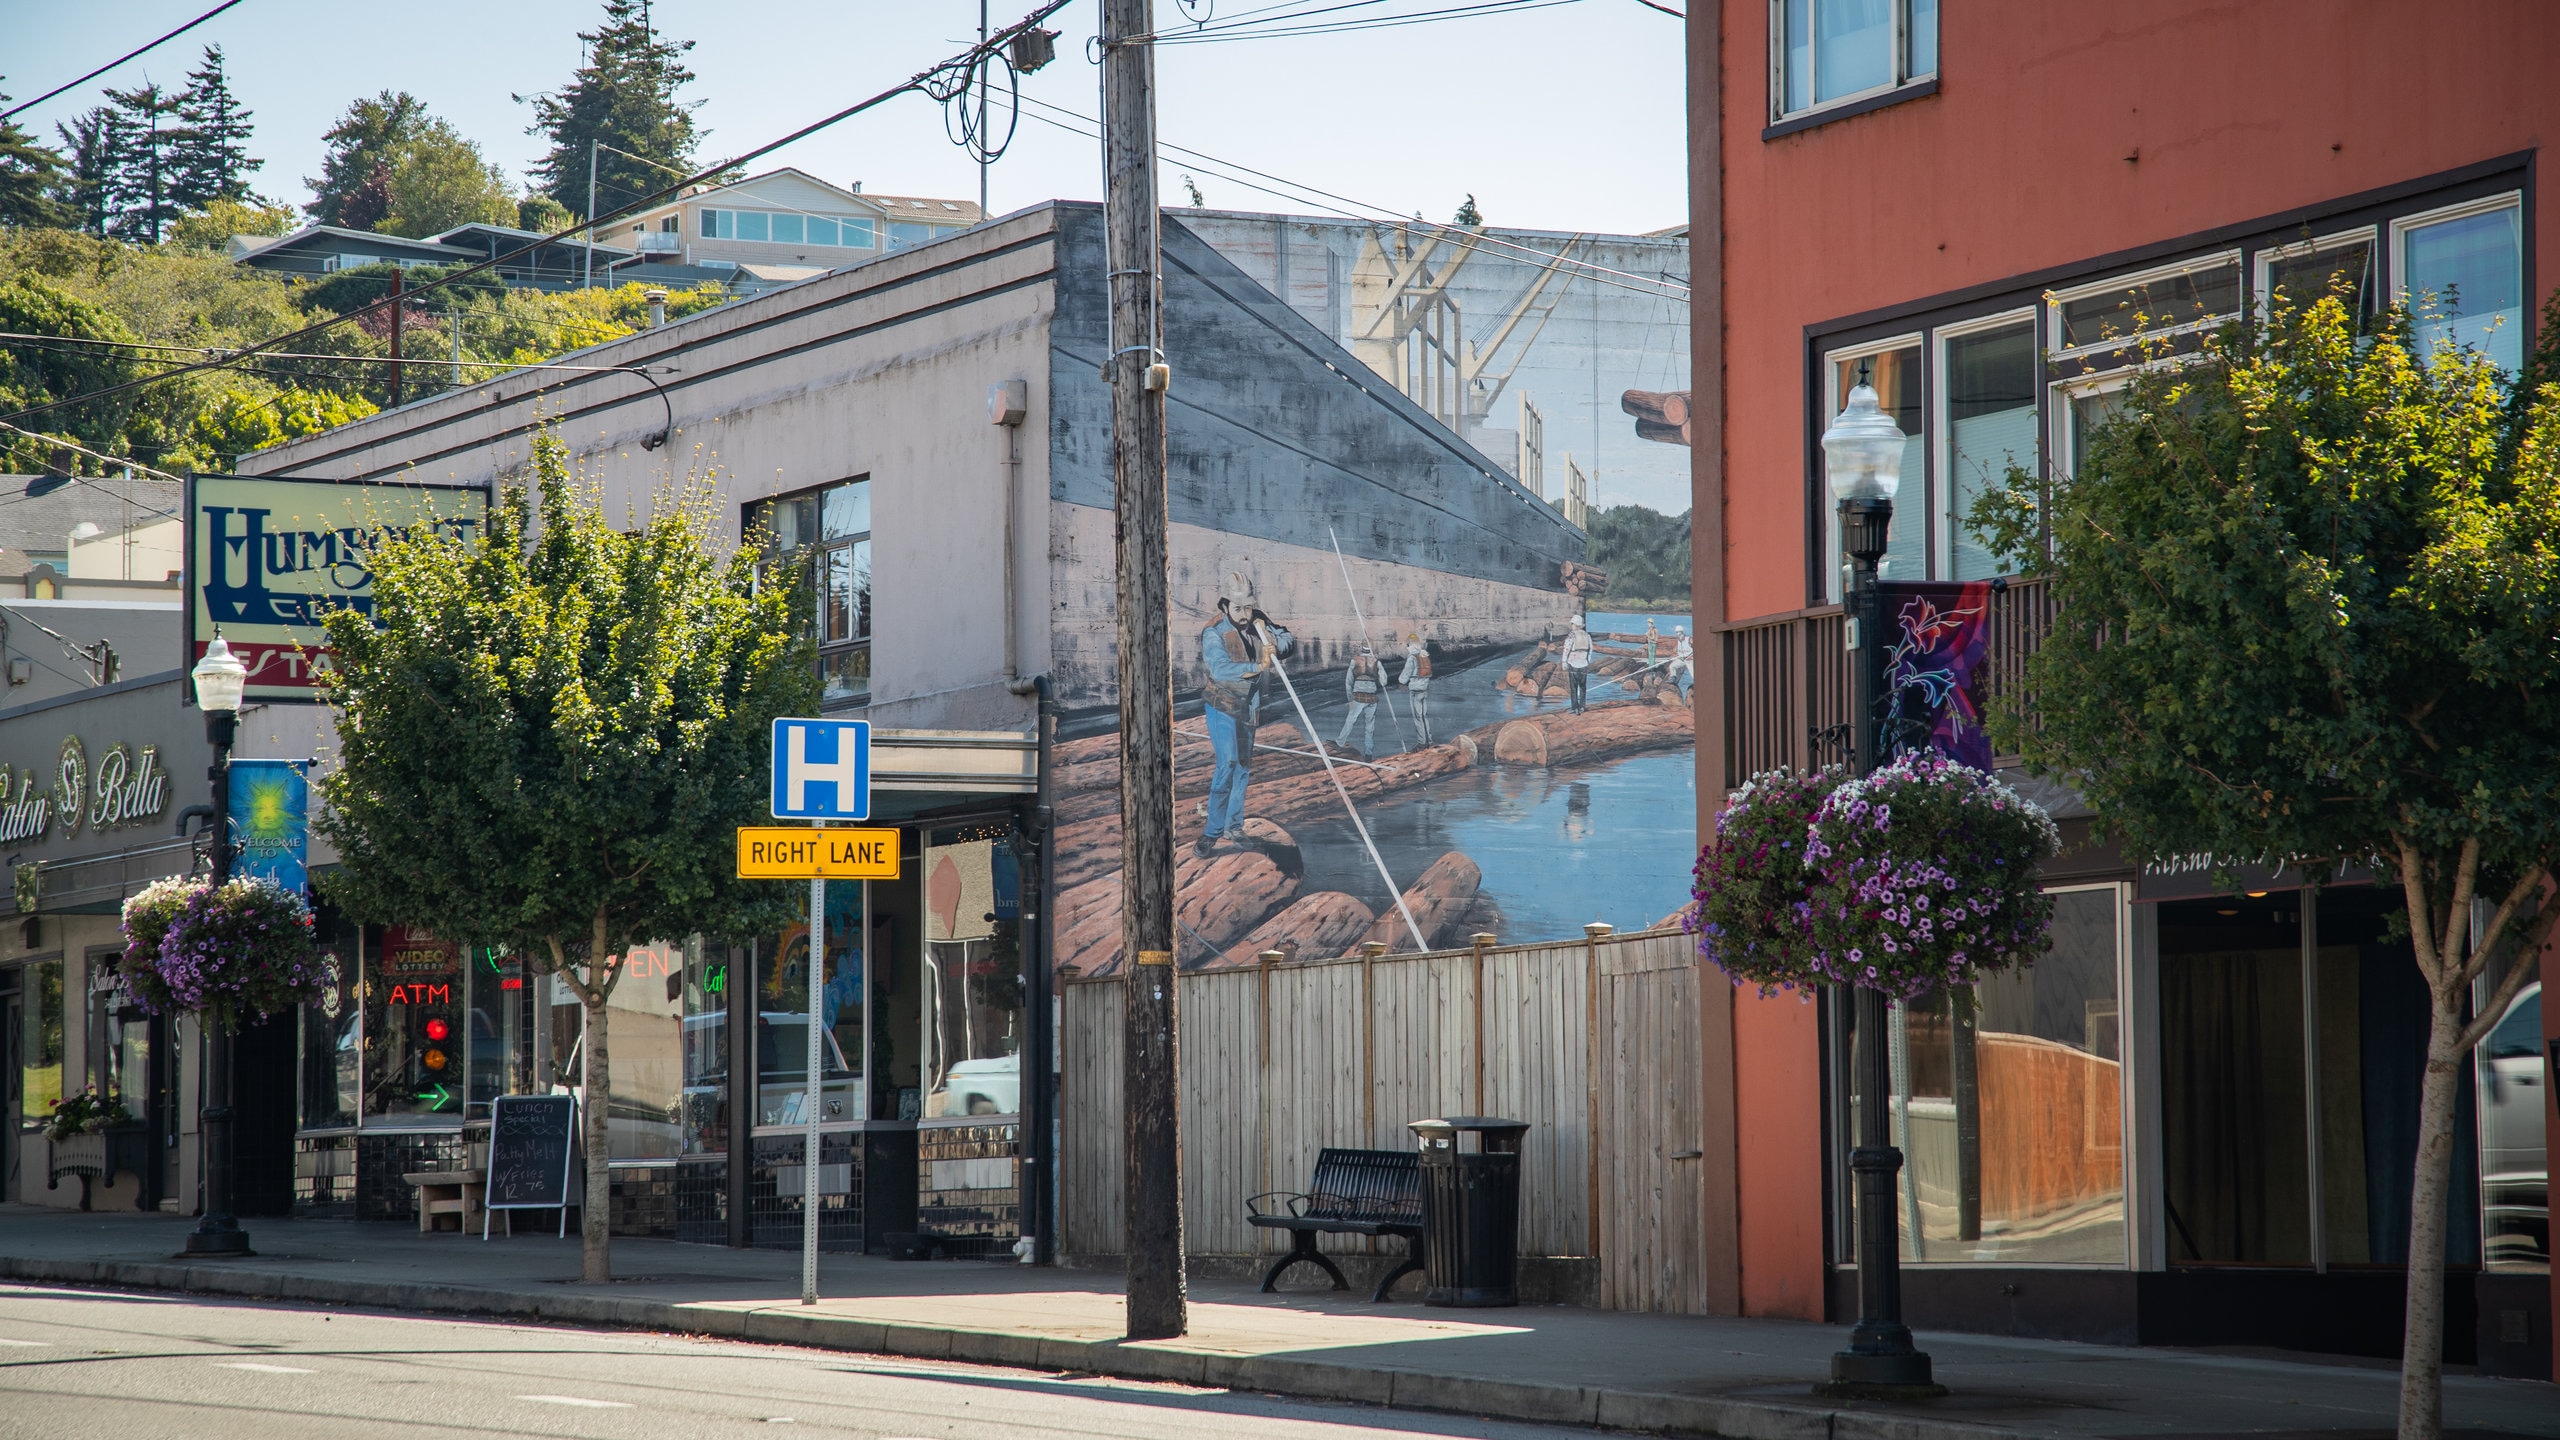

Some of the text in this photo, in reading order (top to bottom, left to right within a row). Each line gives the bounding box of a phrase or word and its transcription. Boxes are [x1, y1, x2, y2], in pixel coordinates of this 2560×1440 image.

[787, 726, 856, 812] H
[91, 750, 165, 824] Bella
[259, 848, 277, 858] TO
[752, 842, 886, 864] RIGHT LANE
[395, 962, 444, 971] LOTTERY
[396, 949, 445, 963] VIDEO
[703, 965, 725, 993] Caf
[389, 984, 449, 1005] ATM
